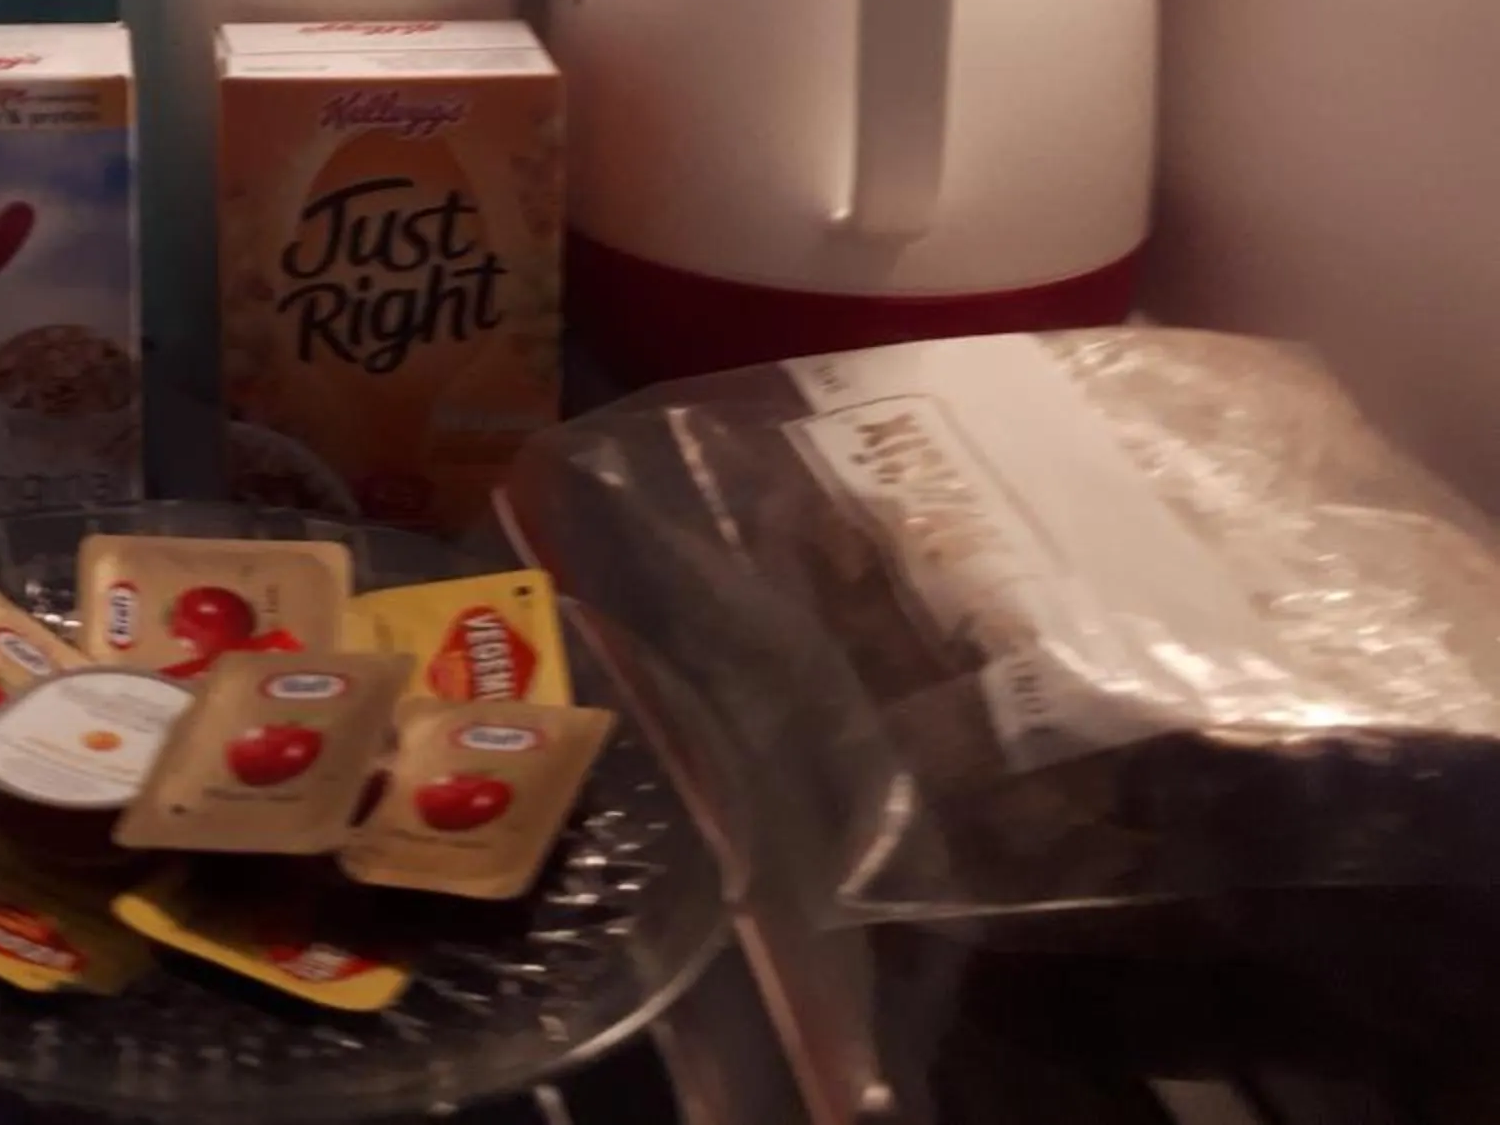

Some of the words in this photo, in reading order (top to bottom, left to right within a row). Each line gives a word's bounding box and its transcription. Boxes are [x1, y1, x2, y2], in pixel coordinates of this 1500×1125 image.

[280, 177, 480, 275] Just
[276, 253, 507, 375] Right
[460, 613, 518, 701] VEGEMI
